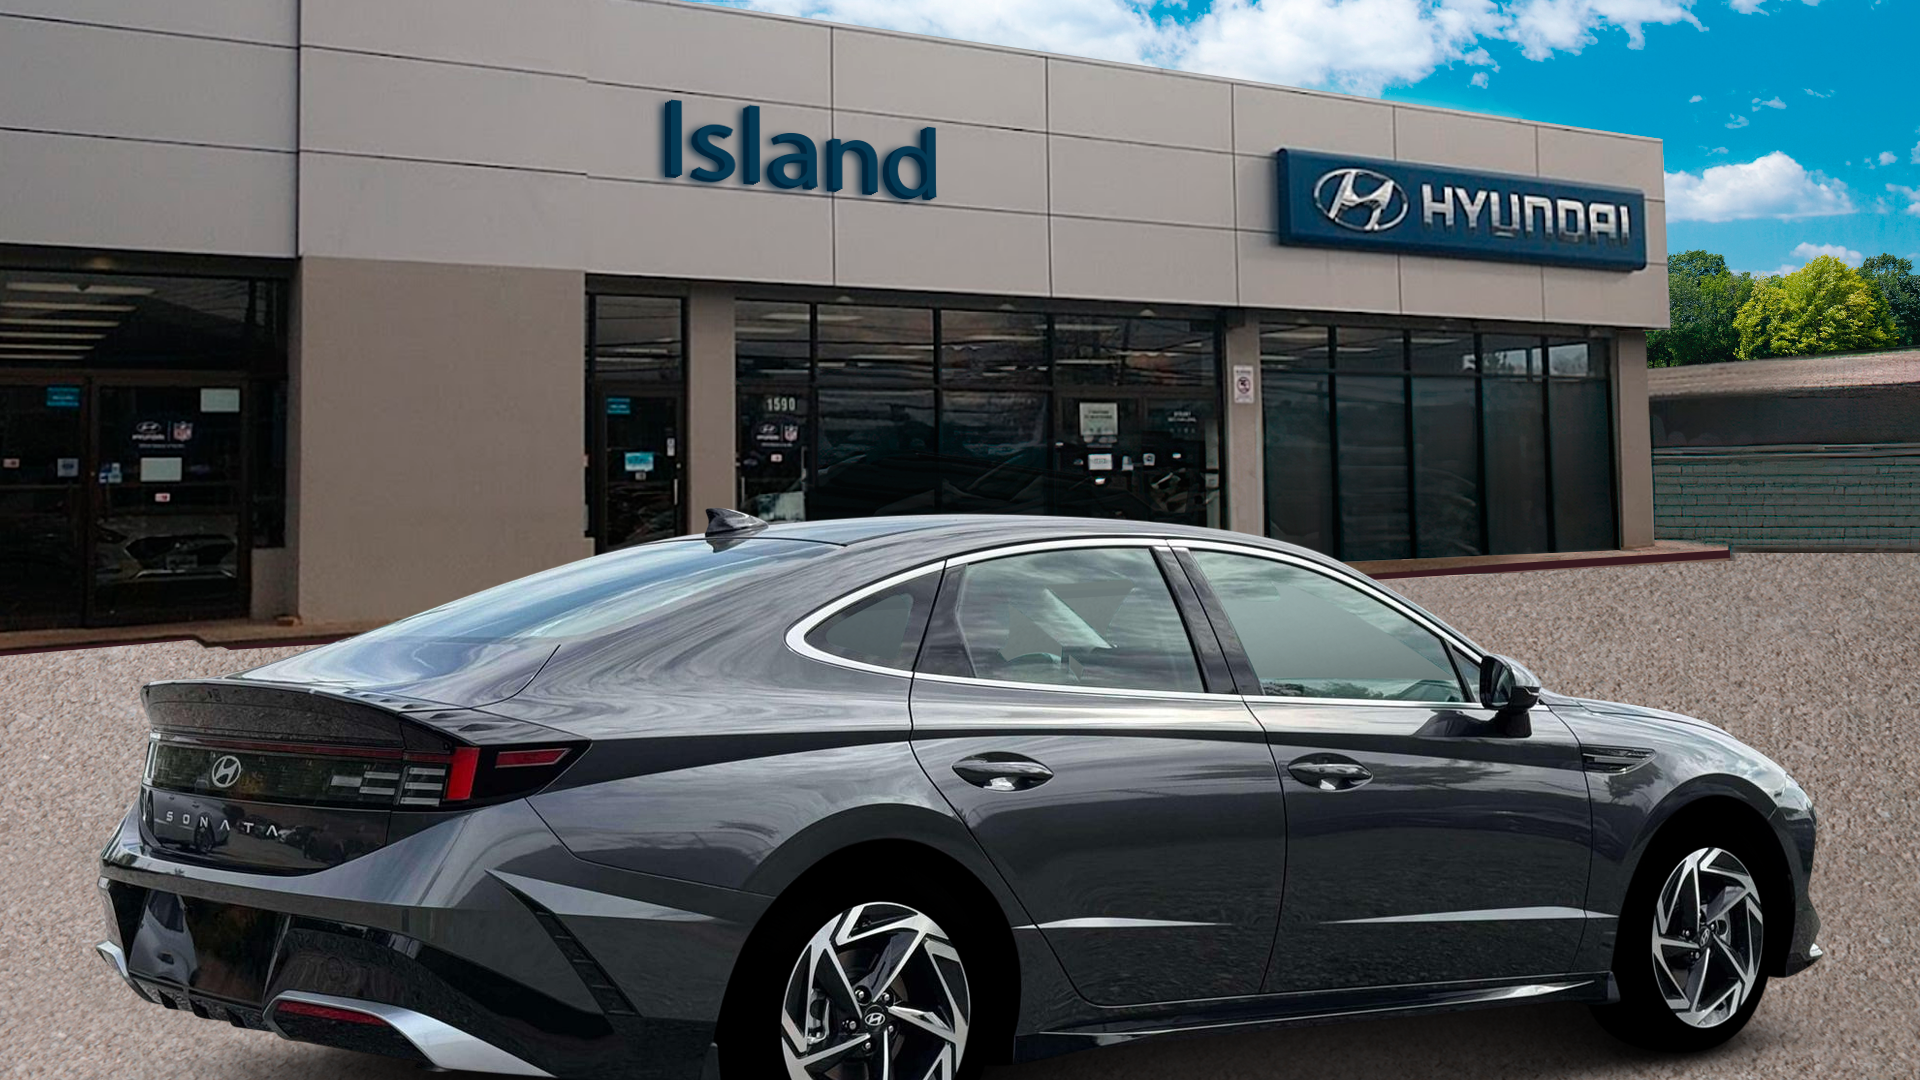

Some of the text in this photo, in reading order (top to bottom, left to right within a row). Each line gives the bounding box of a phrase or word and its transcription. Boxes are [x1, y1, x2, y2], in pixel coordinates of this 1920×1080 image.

[664, 99, 937, 200] Island
[1421, 184, 1631, 246] HYUNDAI
[767, 397, 796, 411] 1590
[166, 811, 278, 837] SONATA
